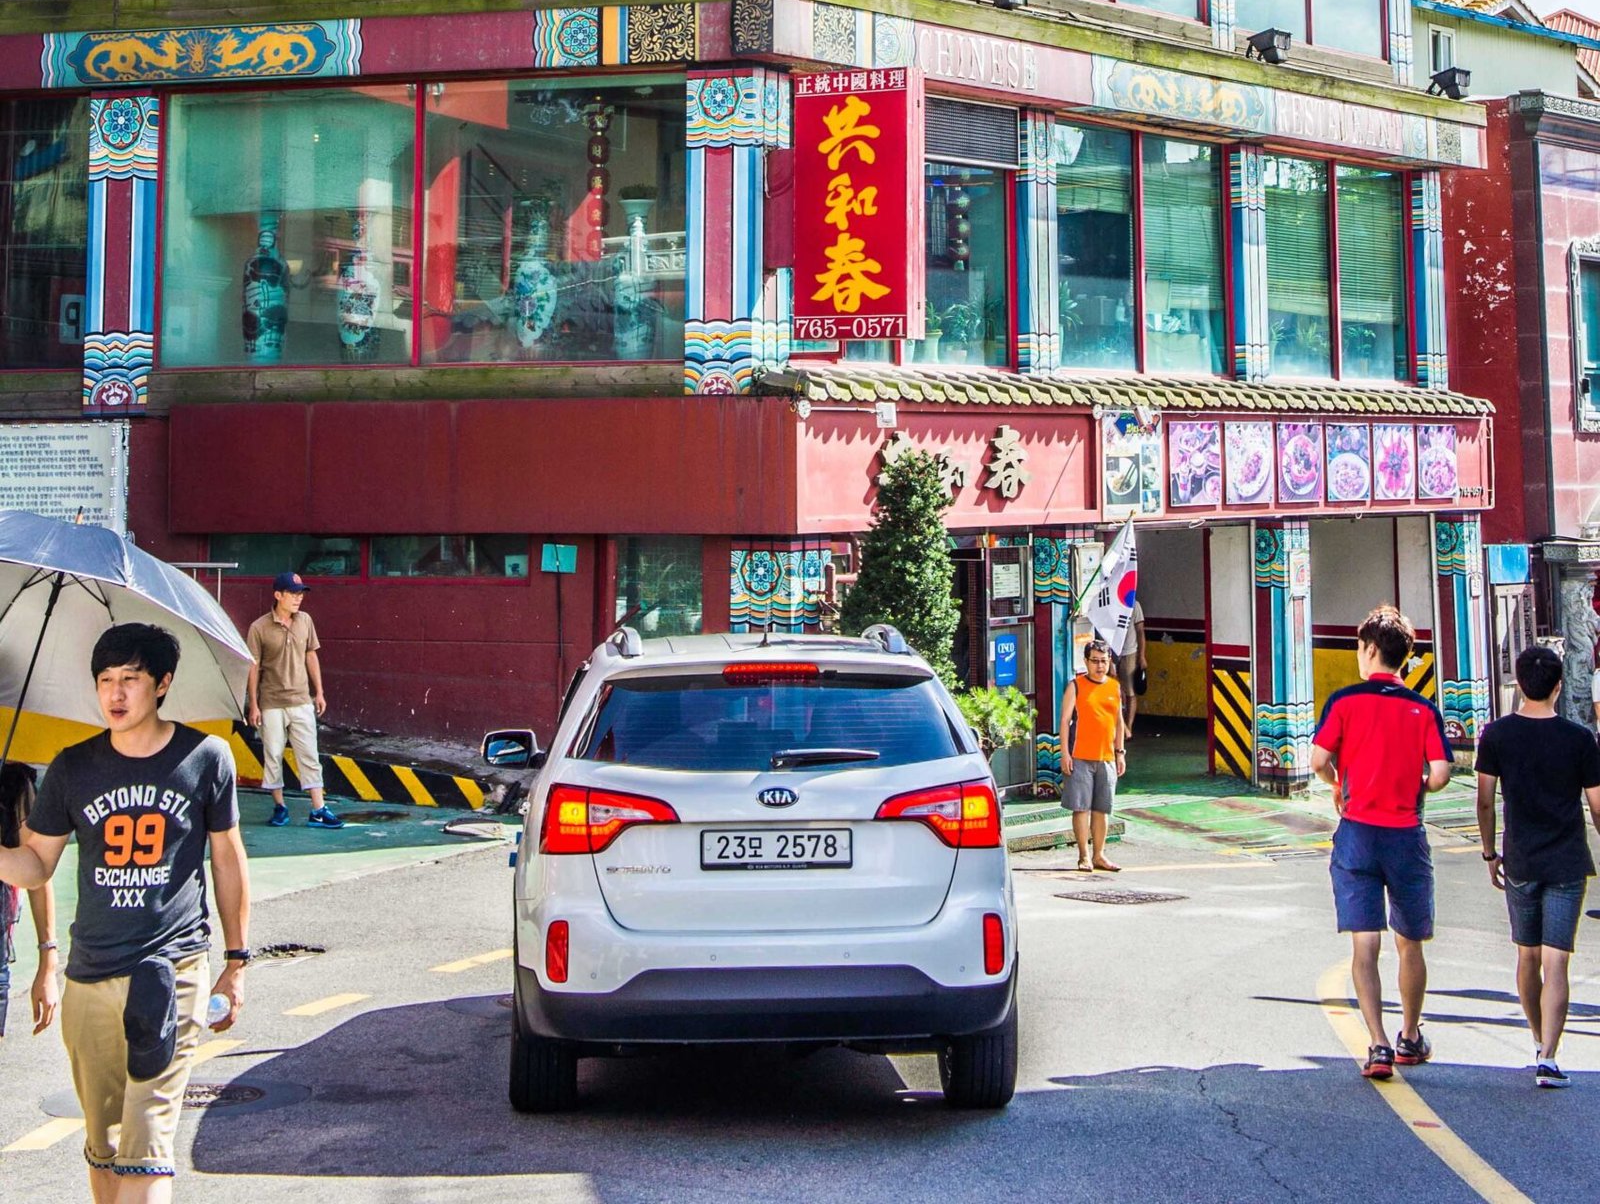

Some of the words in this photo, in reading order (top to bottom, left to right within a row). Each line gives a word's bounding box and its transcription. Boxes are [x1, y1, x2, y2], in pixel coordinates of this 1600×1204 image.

[919, 27, 1037, 90] CHINESE
[797, 70, 905, 94] 正統中國料理
[810, 95, 891, 313] 共和春
[796, 317, 906, 339] 765-0571
[83, 785, 157, 826] BEYOND
[763, 790, 793, 804] KIA
[104, 813, 166, 866] 99
[717, 835, 763, 859] 23모
[776, 834, 838, 859] 2578
[95, 865, 171, 887] EXCHANGE
[111, 888, 147, 907] XXX
